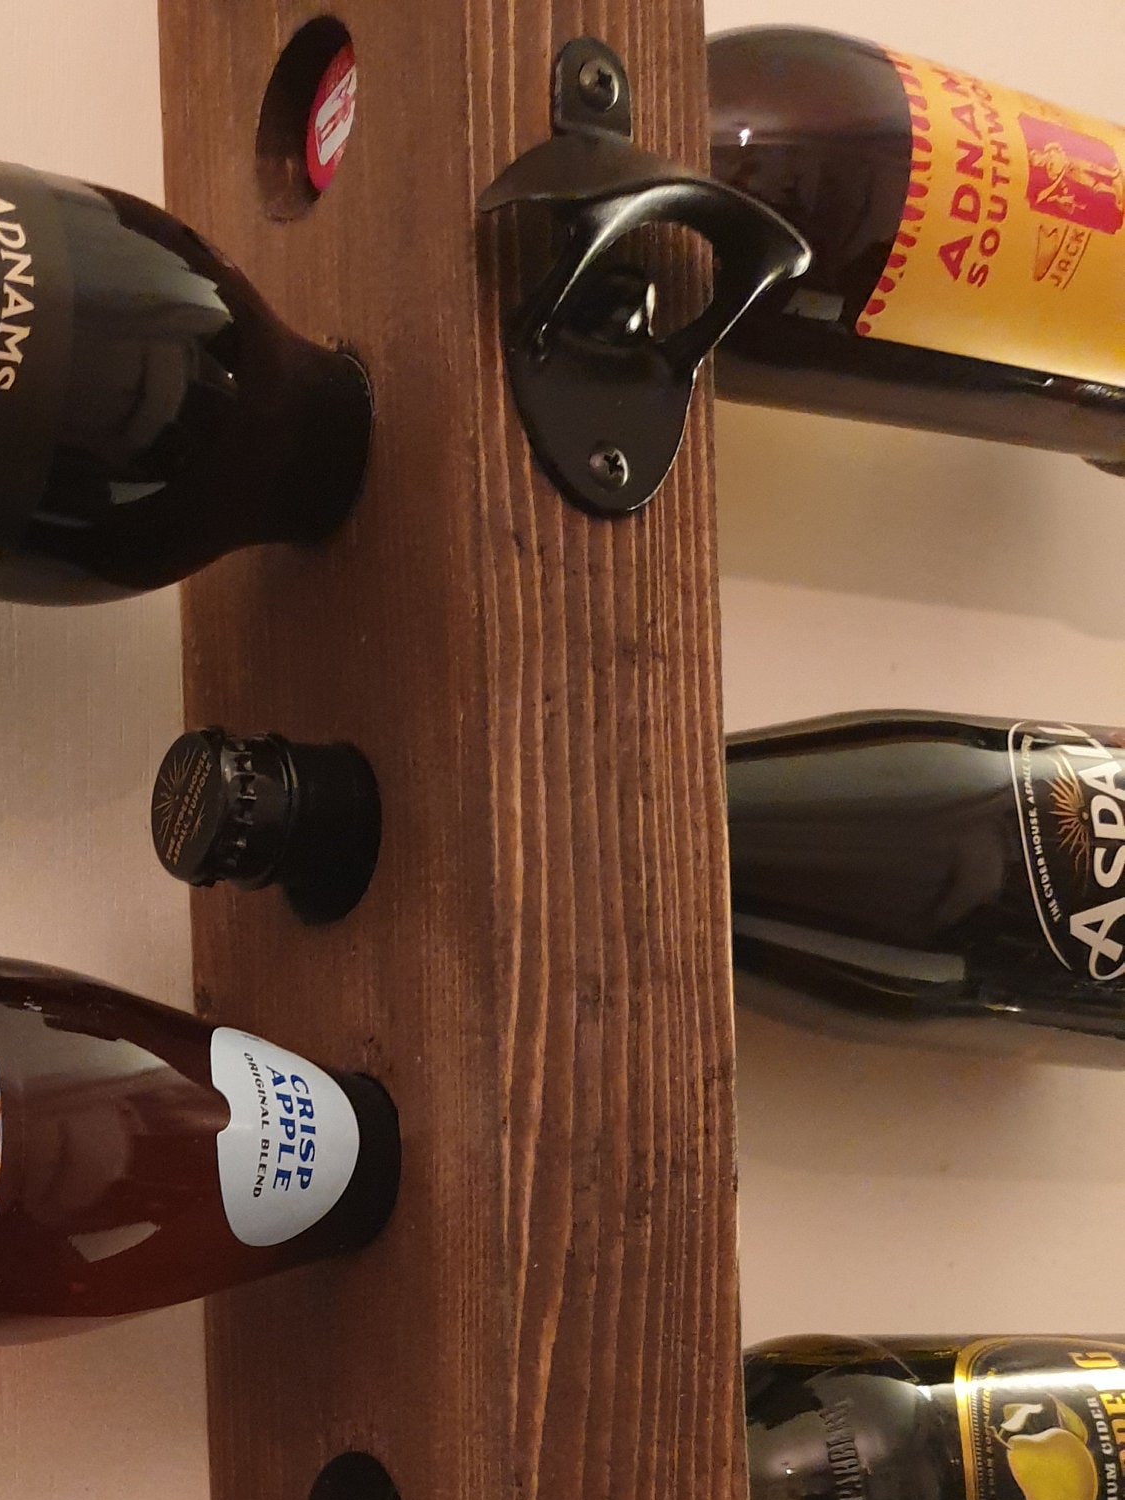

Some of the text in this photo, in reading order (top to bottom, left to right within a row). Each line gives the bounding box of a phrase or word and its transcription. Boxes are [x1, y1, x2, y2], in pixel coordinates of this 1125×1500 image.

[1048, 230, 1086, 288] JACK
[1037, 857, 1055, 899] CYDER
[1048, 899, 1063, 922] THE
[243, 1052, 271, 1130] ORIGINAL
[265, 1064, 297, 1192] APPLE
[289, 1073, 317, 1190] CRISP
[252, 1138, 271, 1199] BLEND
[1087, 1395, 1114, 1455] CIDER
